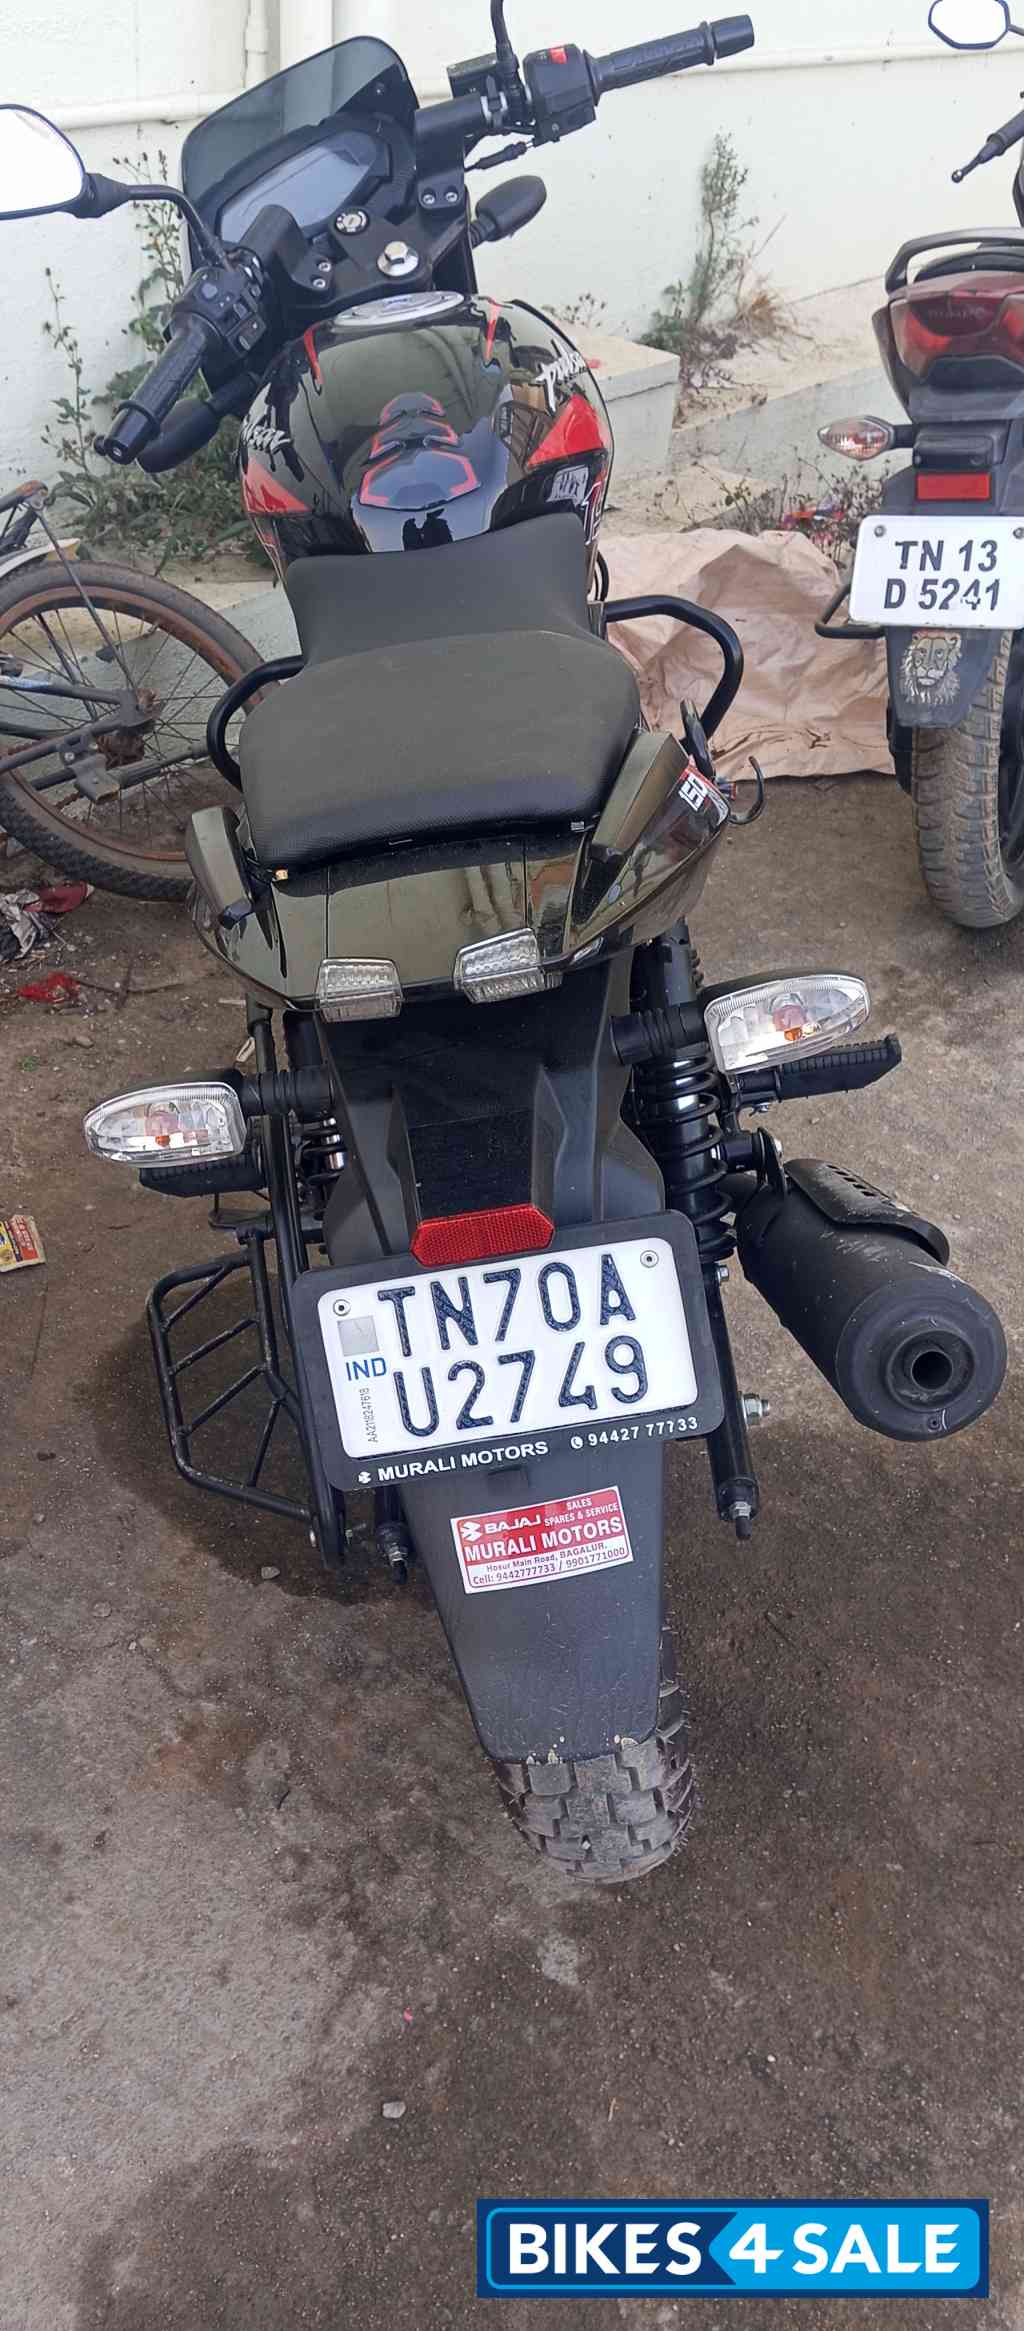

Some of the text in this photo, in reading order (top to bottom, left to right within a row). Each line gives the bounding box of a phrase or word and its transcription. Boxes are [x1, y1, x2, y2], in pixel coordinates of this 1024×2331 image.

[894, 540, 998, 572] TN 13
[884, 578, 1000, 611] D 5241
[678, 772, 708, 812] 150
[377, 1253, 636, 1357] TN70A
[345, 1357, 387, 1381] IND
[393, 1335, 649, 1437] U2749
[588, 1416, 698, 1446] 94427 77733
[377, 1441, 549, 1481] MURALI MOTORS
[544, 1502, 620, 1527] SPARES & SERVICE
[566, 1497, 593, 1511] SALES
[464, 1516, 623, 1562] MURALI MOTORS
[484, 1514, 541, 1535] BAJAJ
[472, 1573, 494, 1585] Cell:
[496, 1564, 556, 1582] 9442777733
[566, 1547, 626, 1568] 9901771000
[512, 1558, 532, 1569] Main
